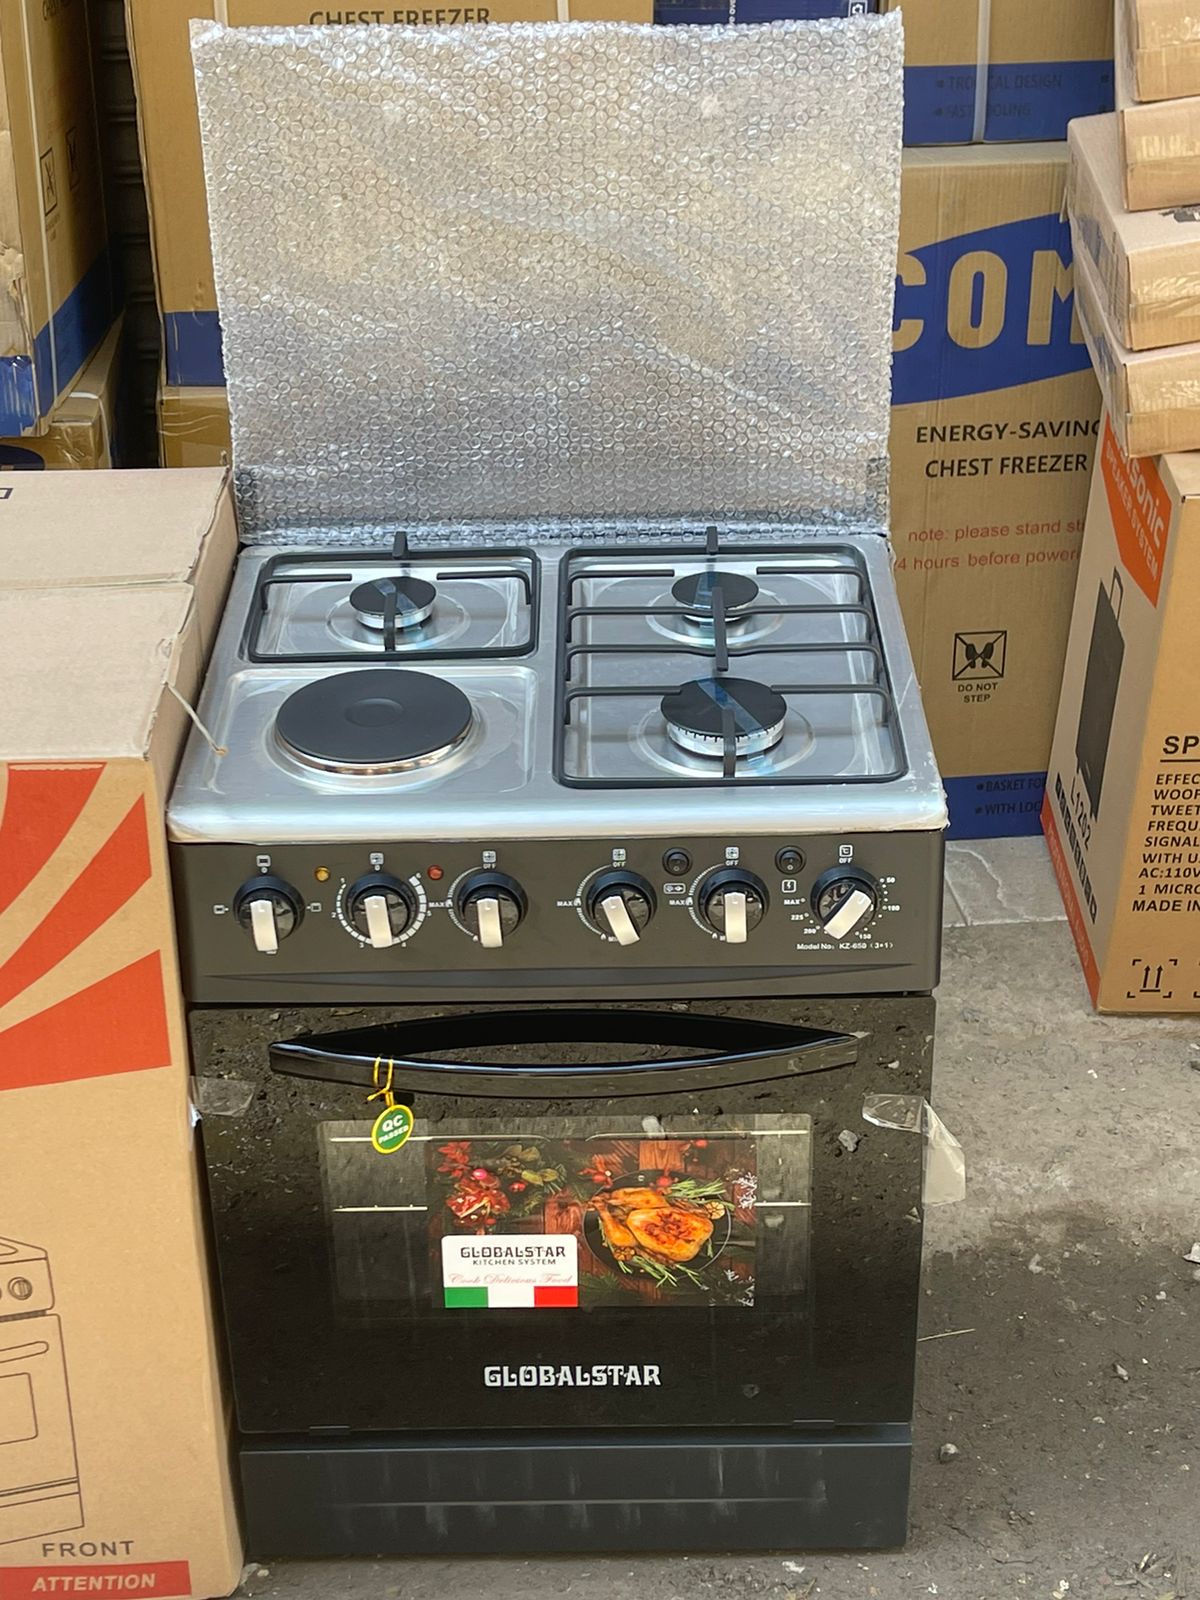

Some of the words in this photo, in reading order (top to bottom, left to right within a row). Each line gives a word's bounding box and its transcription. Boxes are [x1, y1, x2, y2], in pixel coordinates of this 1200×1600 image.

[309, 11, 385, 26] CHEST
[392, 8, 491, 26] FREEZER
[925, 457, 994, 478] CHEST
[999, 453, 1089, 476] FREEZER
[908, 528, 949, 542] note:
[954, 524, 1010, 543] please
[1015, 519, 1061, 537] stand
[913, 553, 960, 571] hours
[967, 550, 1020, 567] before
[957, 683, 974, 693] DO
[975, 681, 999, 692] NOT
[963, 693, 991, 704] STEP
[985, 778, 1026, 792] BASKET
[984, 802, 1016, 816] WITH
[1147, 820, 1200, 833] FREQU
[1142, 853, 1183, 864] WITH
[1188, 853, 1200, 864] U
[1138, 885, 1146, 895] 1
[1132, 900, 1183, 912] MADE
[796, 942, 820, 950] Model
[382, 1114, 404, 1132] QC
[460, 1246, 566, 1259] GLOBALSTAR
[472, 1258, 516, 1266] KITCHEN
[518, 1258, 557, 1266] SYSTEM
[448, 1272, 482, 1285] Cook
[483, 1364, 662, 1387] GLOBALSTAR
[42, 1540, 135, 1558] FRONT
[31, 1573, 156, 1593] ATTENTION
